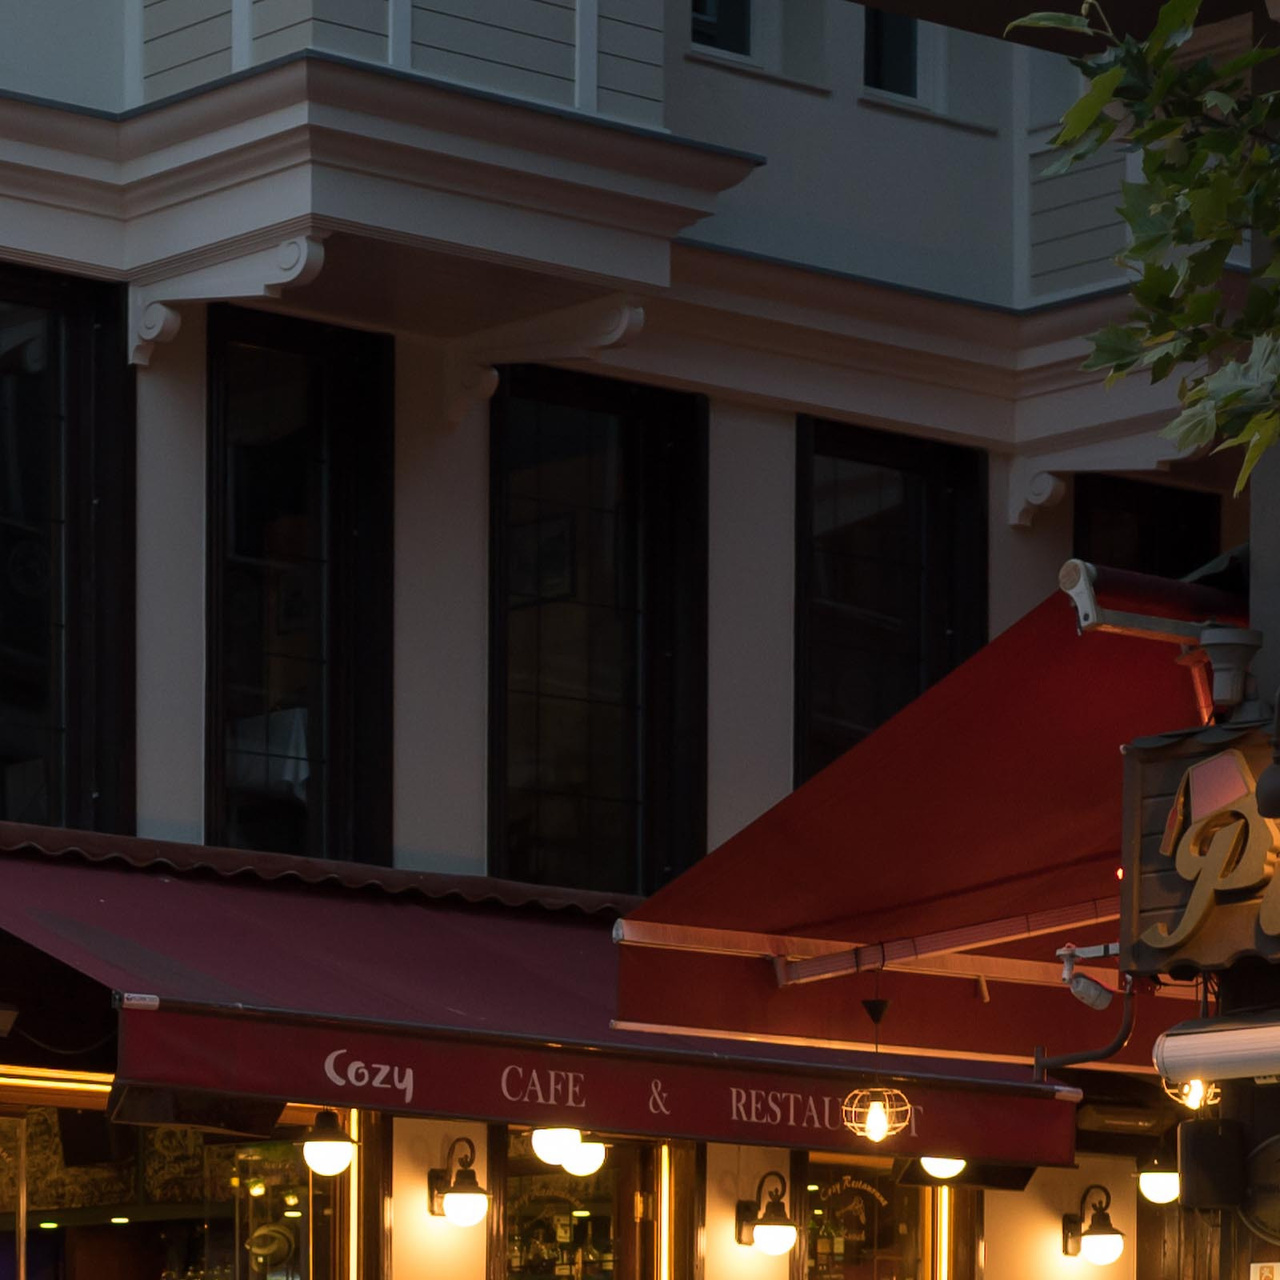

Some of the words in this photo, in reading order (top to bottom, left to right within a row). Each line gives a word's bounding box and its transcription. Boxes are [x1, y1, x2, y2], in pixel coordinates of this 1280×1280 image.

[324, 1049, 413, 1104] Cozy
[501, 1065, 586, 1107] CAFE
[649, 1079, 671, 1115] &
[730, 1087, 924, 1138] RESTAUT
